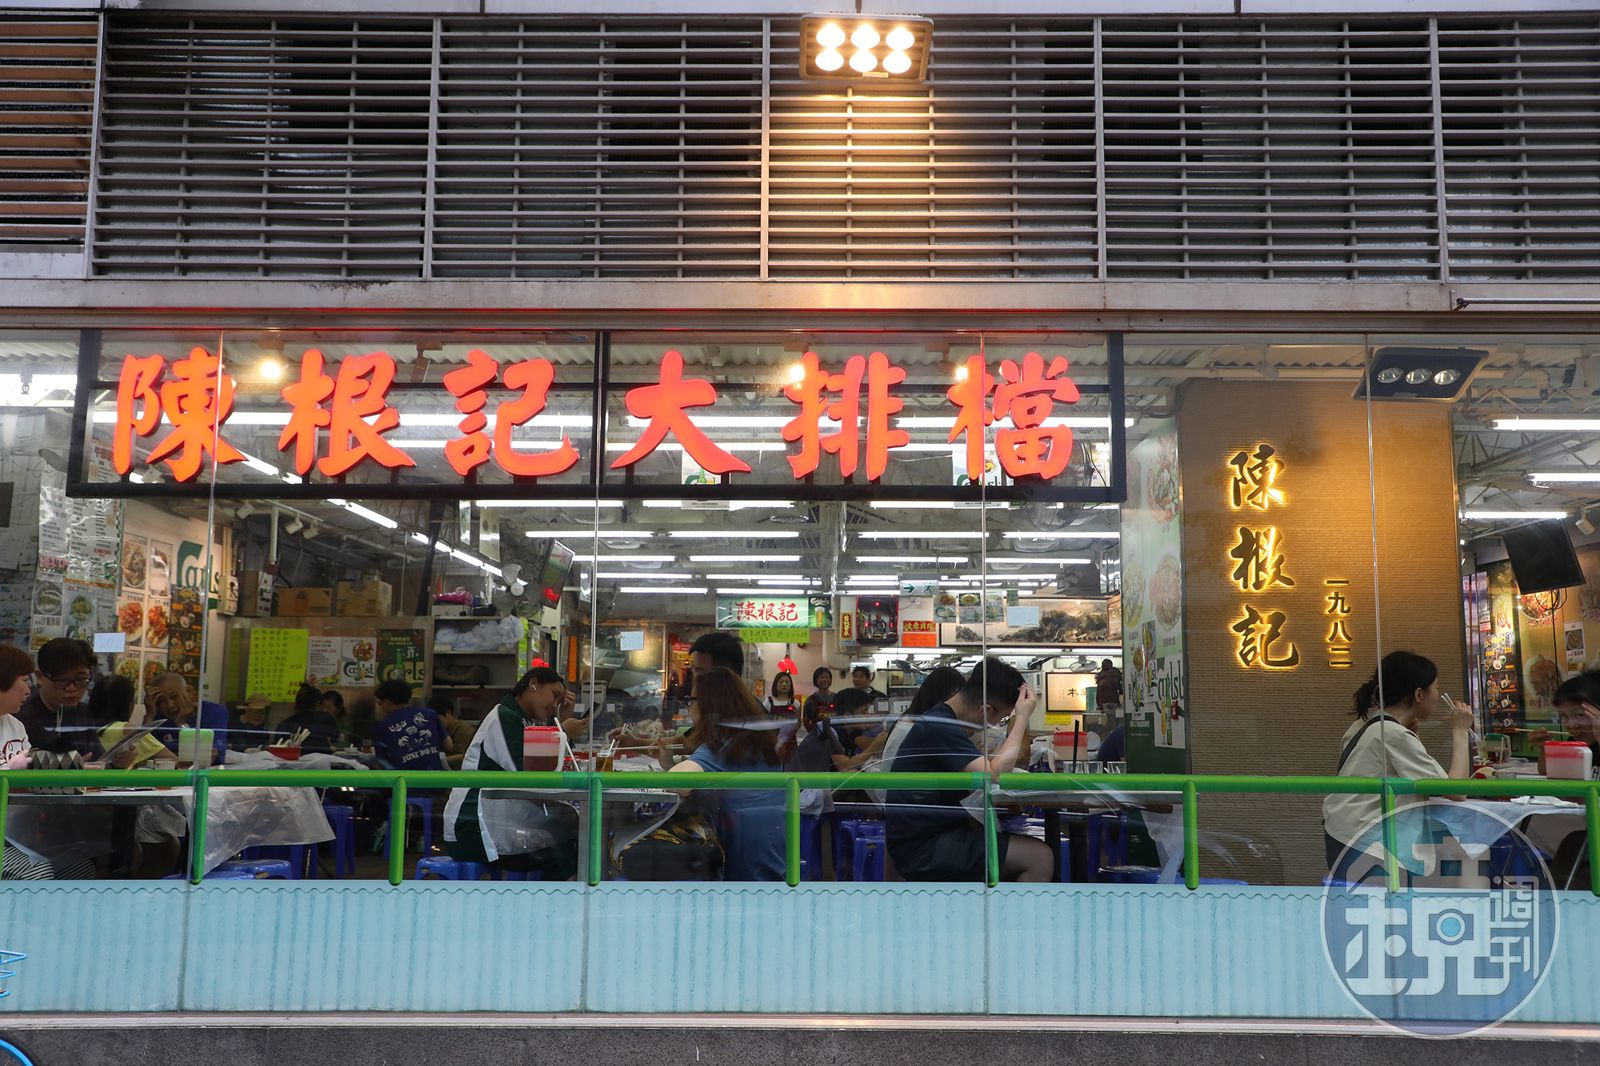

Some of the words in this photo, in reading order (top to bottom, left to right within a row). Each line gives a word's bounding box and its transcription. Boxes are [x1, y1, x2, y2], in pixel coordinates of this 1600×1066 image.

[111, 346, 1080, 482] 陳根記大排檔
[735, 600, 799, 622] 陳根記
[1326, 579, 1354, 665] 一九八二
